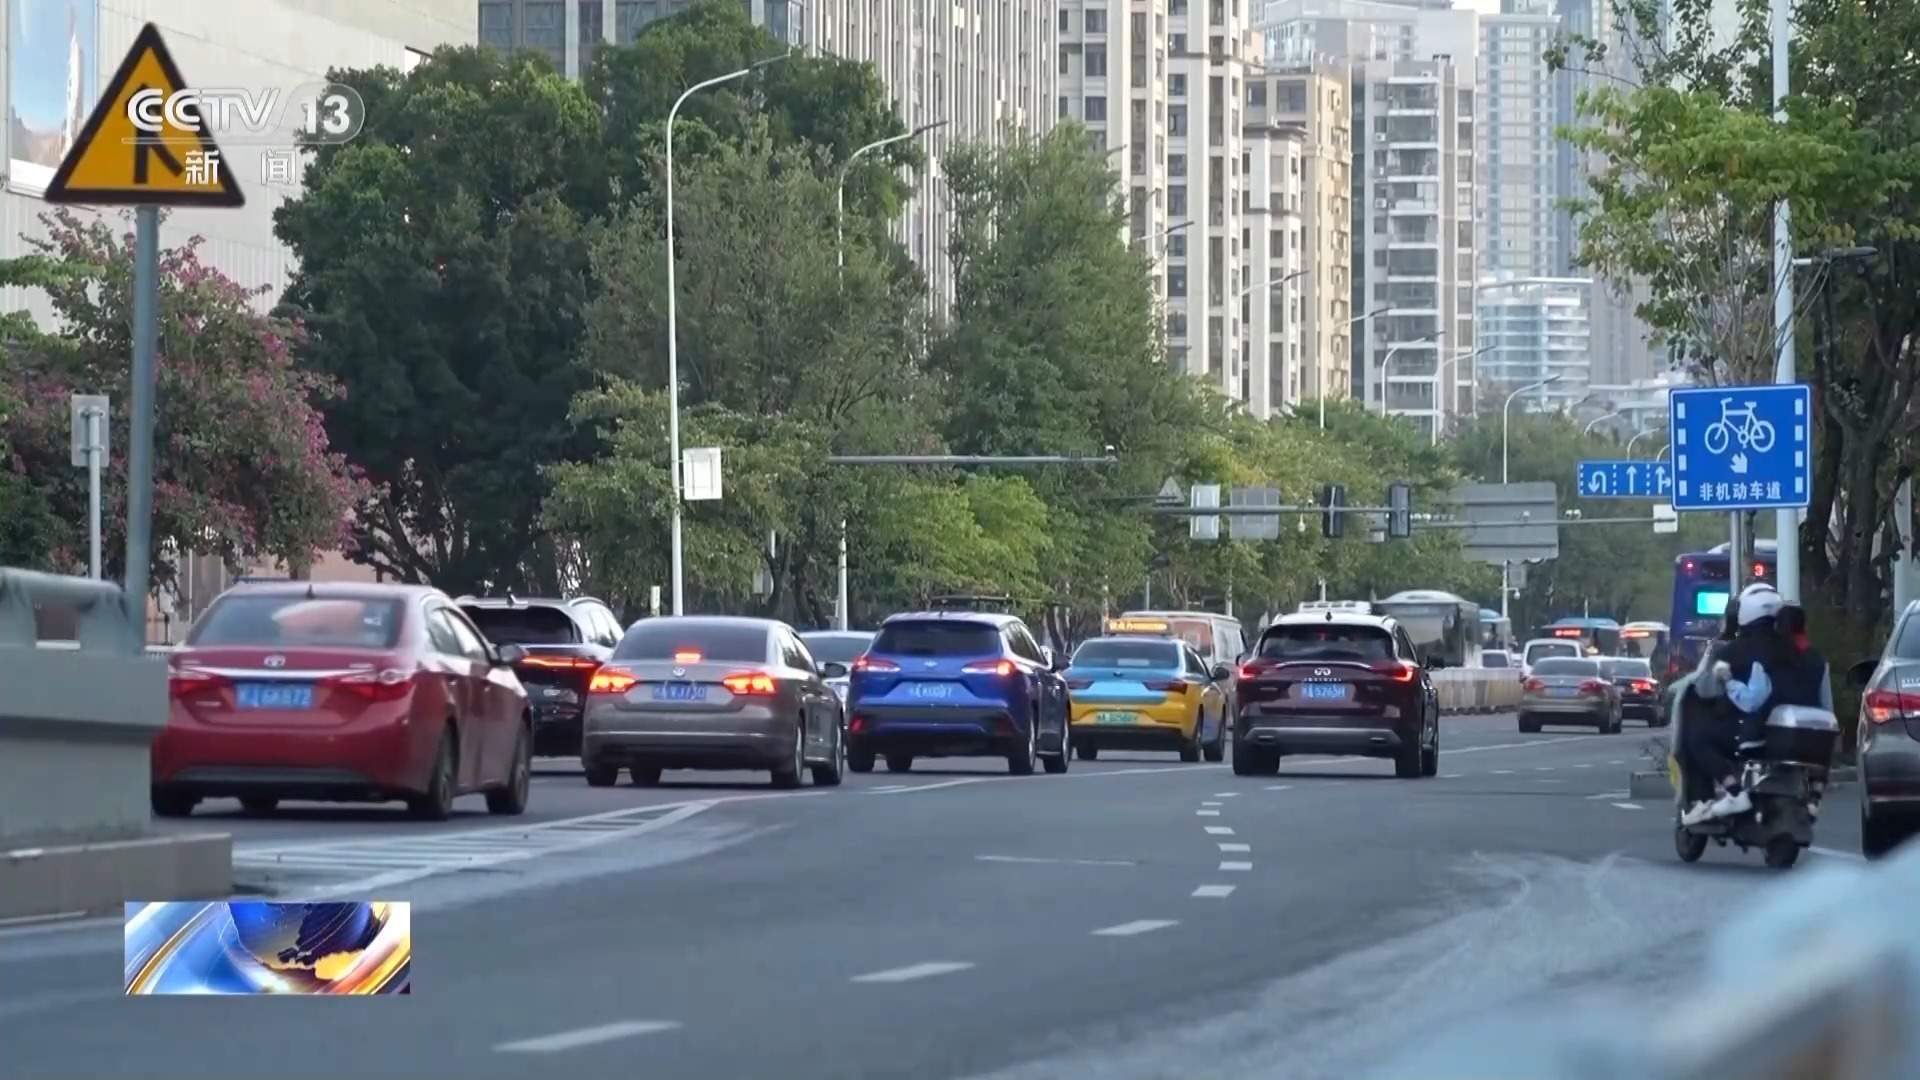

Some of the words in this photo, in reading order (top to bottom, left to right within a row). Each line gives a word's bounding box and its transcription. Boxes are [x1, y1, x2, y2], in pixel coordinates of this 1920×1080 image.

[1699, 481, 1782, 501] 非机动车道
